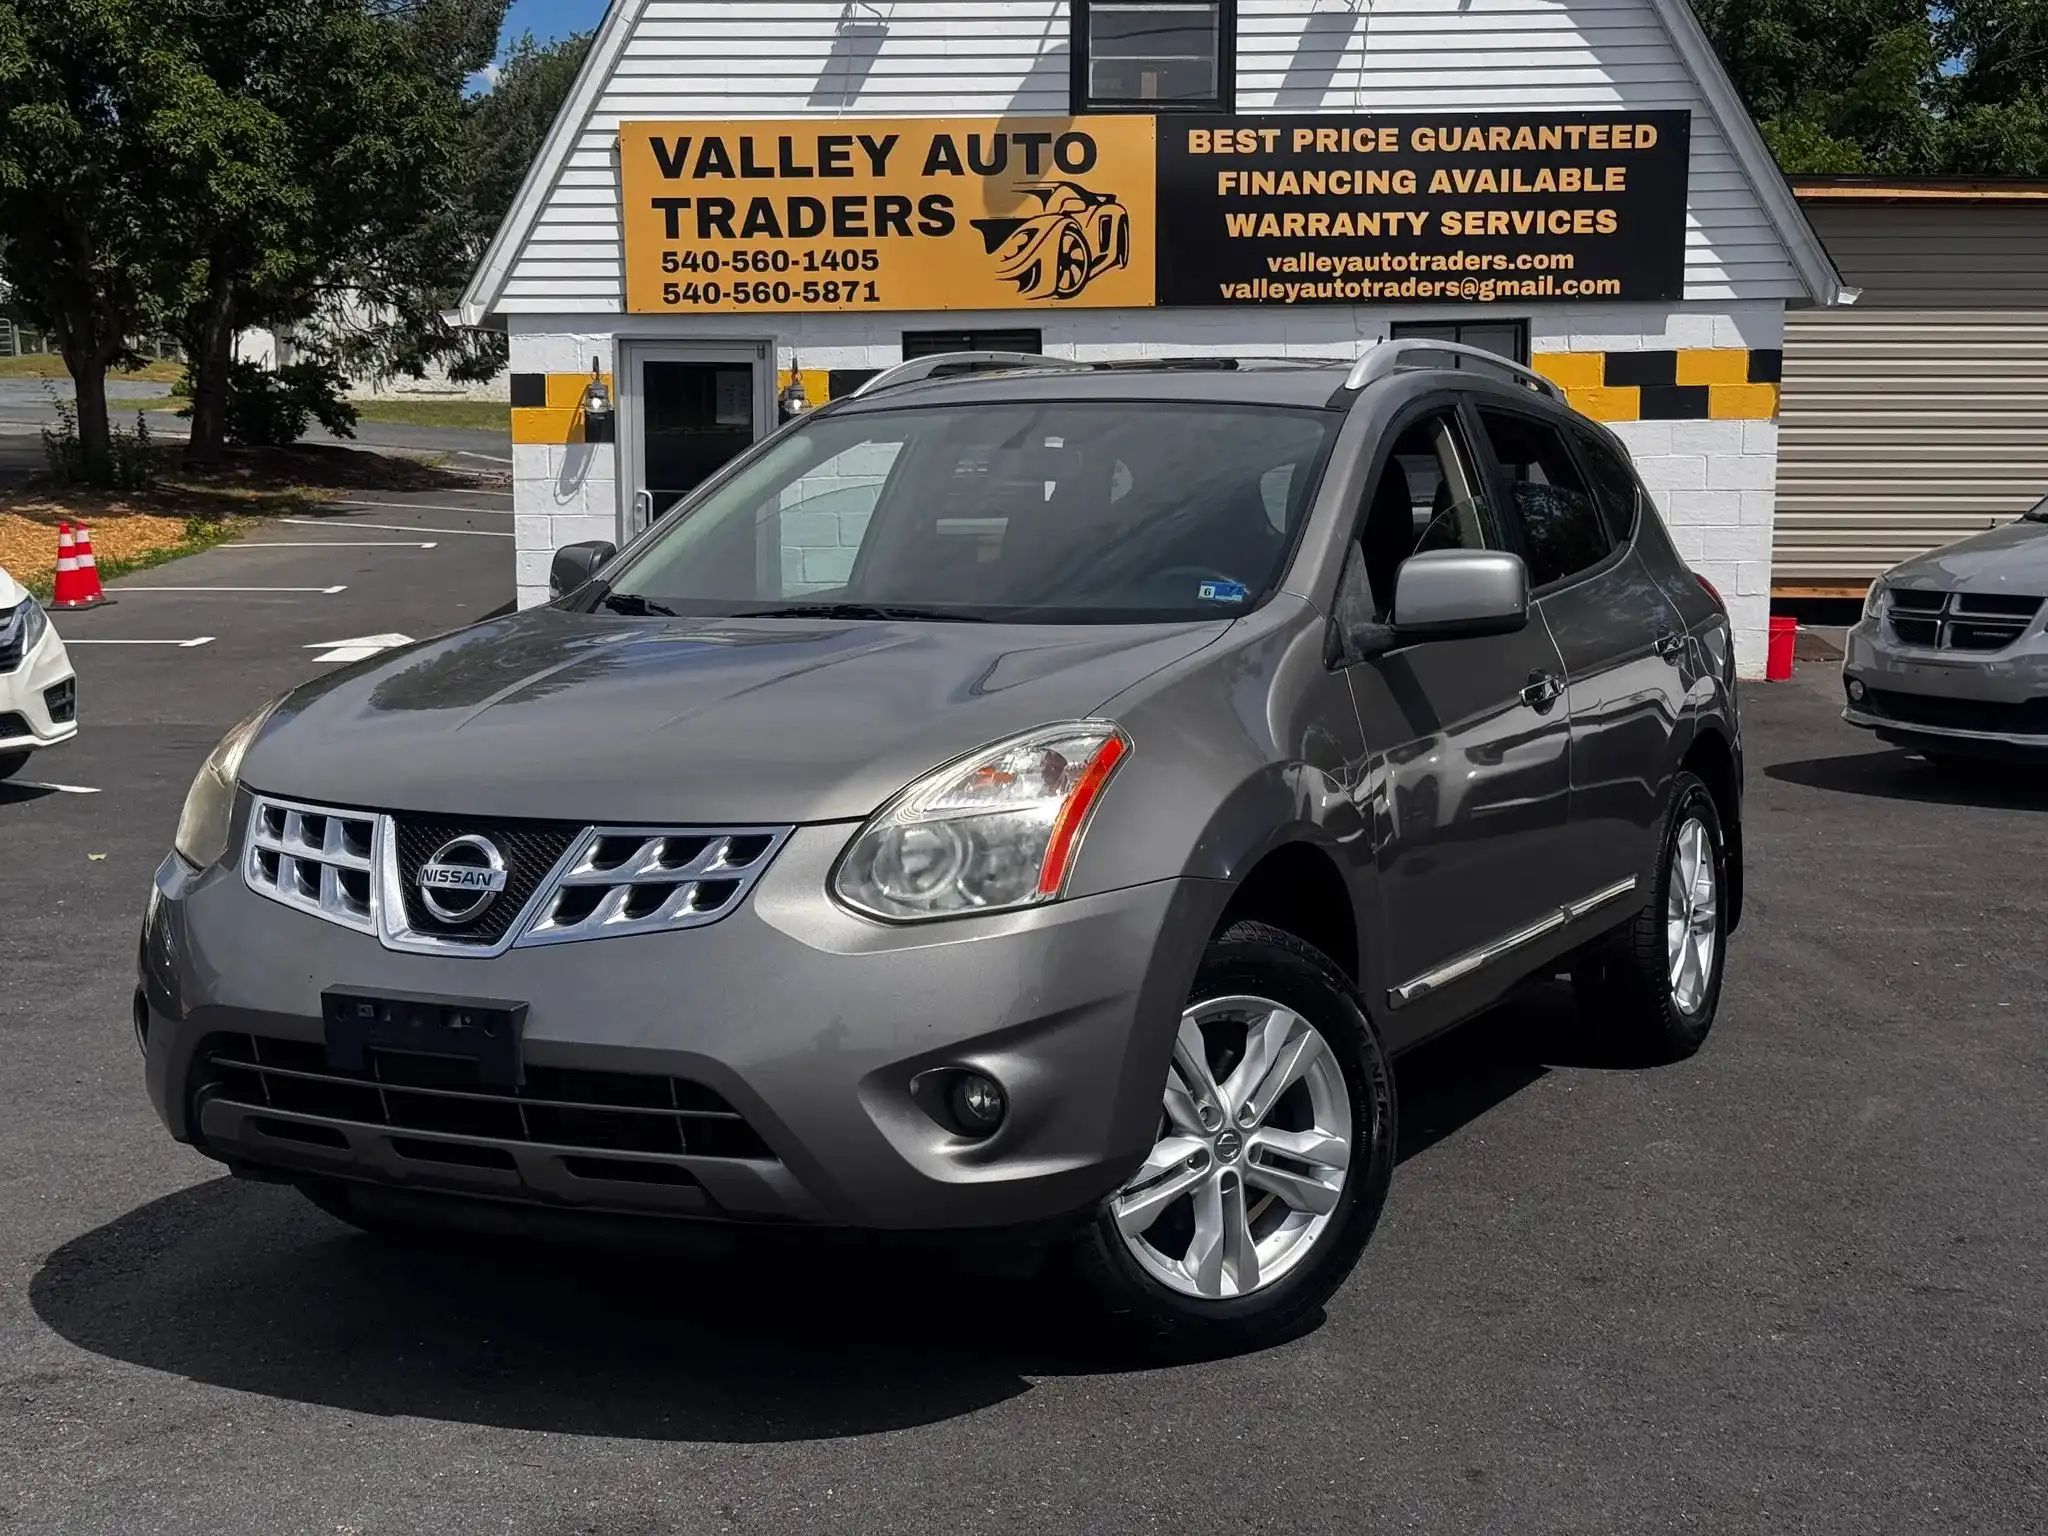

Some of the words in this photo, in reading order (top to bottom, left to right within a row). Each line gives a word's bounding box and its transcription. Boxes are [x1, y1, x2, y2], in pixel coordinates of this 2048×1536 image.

[1189, 129, 1280, 153] BEST
[1294, 128, 1398, 152] PRICE
[1411, 125, 1657, 151] GUARANTEED
[649, 135, 899, 178] VALLEY
[922, 132, 1096, 176] AUTO
[1219, 170, 1416, 195] FINANCING
[1428, 167, 1626, 193] AVAILABLE
[652, 195, 955, 238] TRADERS
[1226, 212, 1429, 237] WARRANTY
[1441, 209, 1617, 235] SERVICES
[662, 250, 878, 273] 540-560-1405
[1267, 251, 1574, 277] valleyautotraders.com
[663, 281, 879, 304] 540-560-5871
[1220, 275, 1620, 302] valleyautotraders@gmail.com
[1203, 587, 1212, 597] 6
[422, 869, 492, 886] NISSAN
